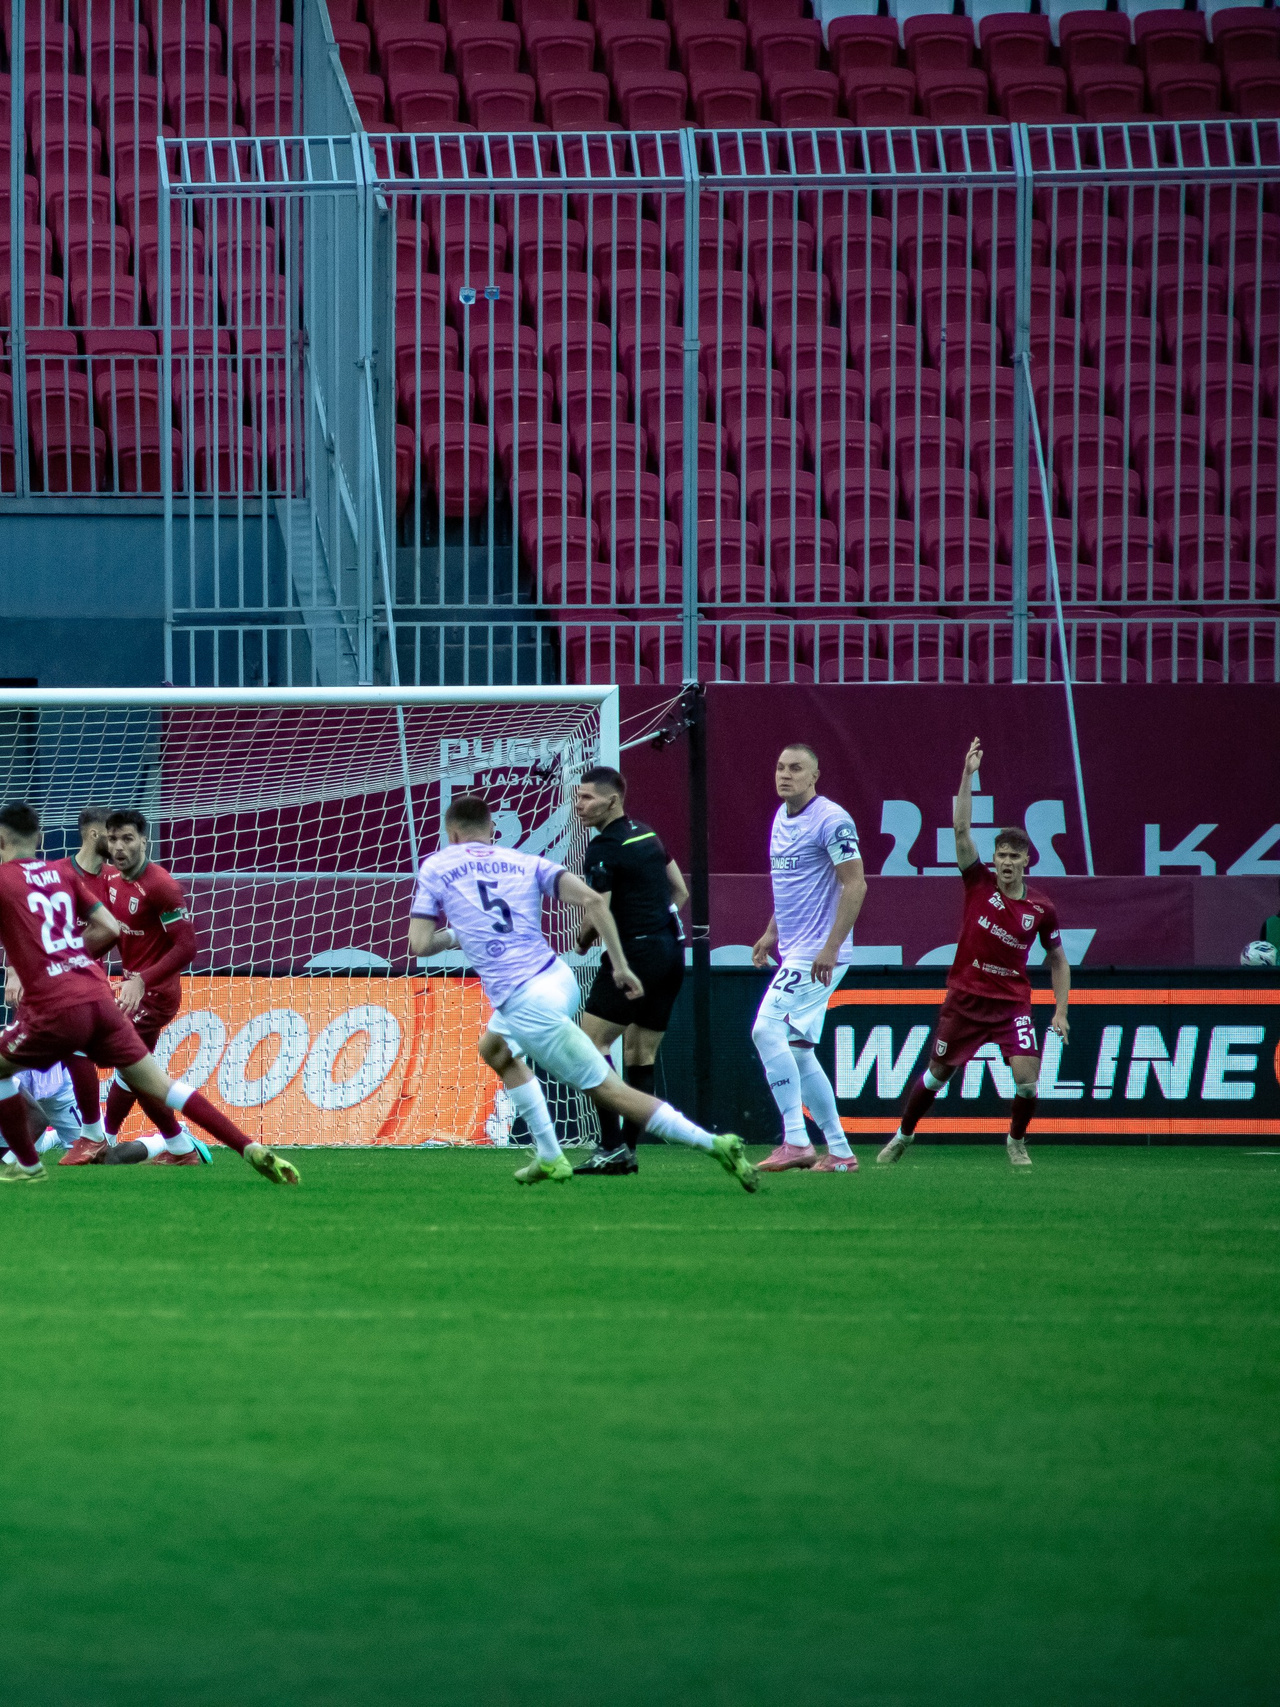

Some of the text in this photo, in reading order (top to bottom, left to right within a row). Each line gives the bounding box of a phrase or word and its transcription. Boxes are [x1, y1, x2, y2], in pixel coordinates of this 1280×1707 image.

[441, 861, 525, 886] ДЖУРАСОВИЧ
[27, 891, 84, 954] 22
[477, 879, 514, 934] 5
[773, 968, 802, 994] 22
[1017, 1028, 1038, 1050] 51
[834, 1024, 1267, 1100] WNLINE
